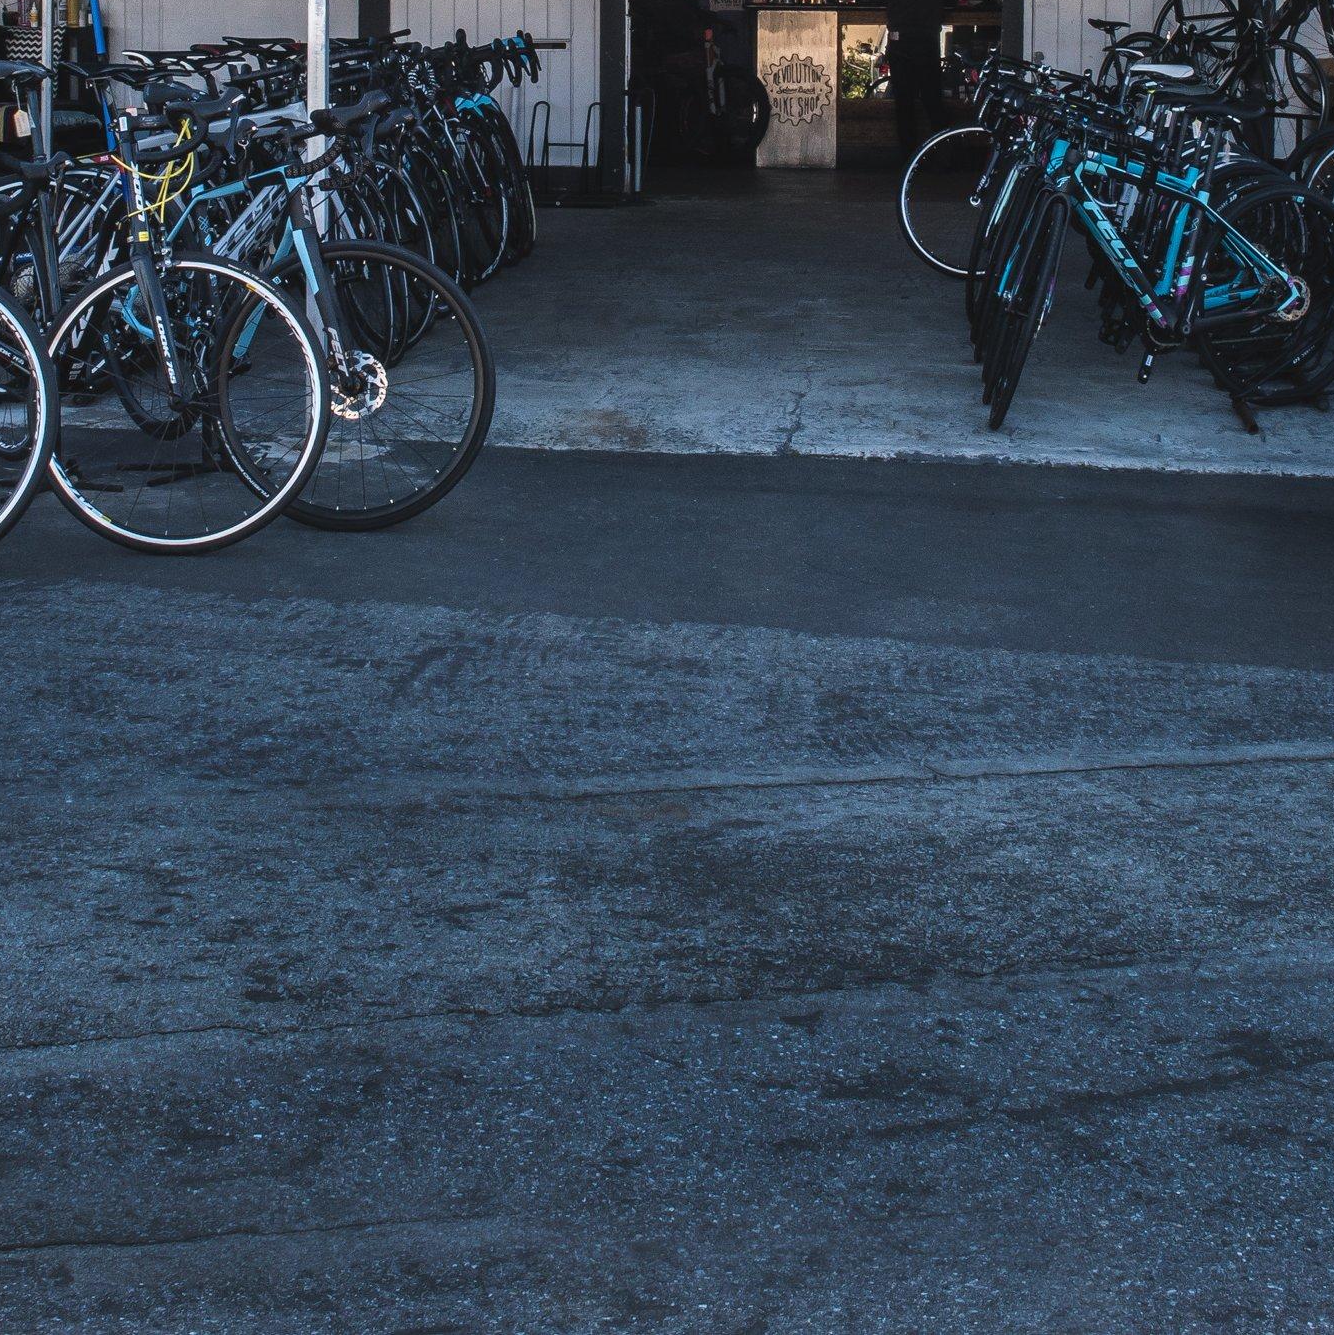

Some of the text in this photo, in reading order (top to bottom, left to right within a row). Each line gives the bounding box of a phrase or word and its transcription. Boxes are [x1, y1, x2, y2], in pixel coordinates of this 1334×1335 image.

[773, 62, 821, 86] REVOLUTION
[773, 96, 820, 117] BIKE SHOP
[1083, 200, 1143, 274] FELT
[155, 315, 172, 361] LOOK
[327, 327, 350, 378] FELT
